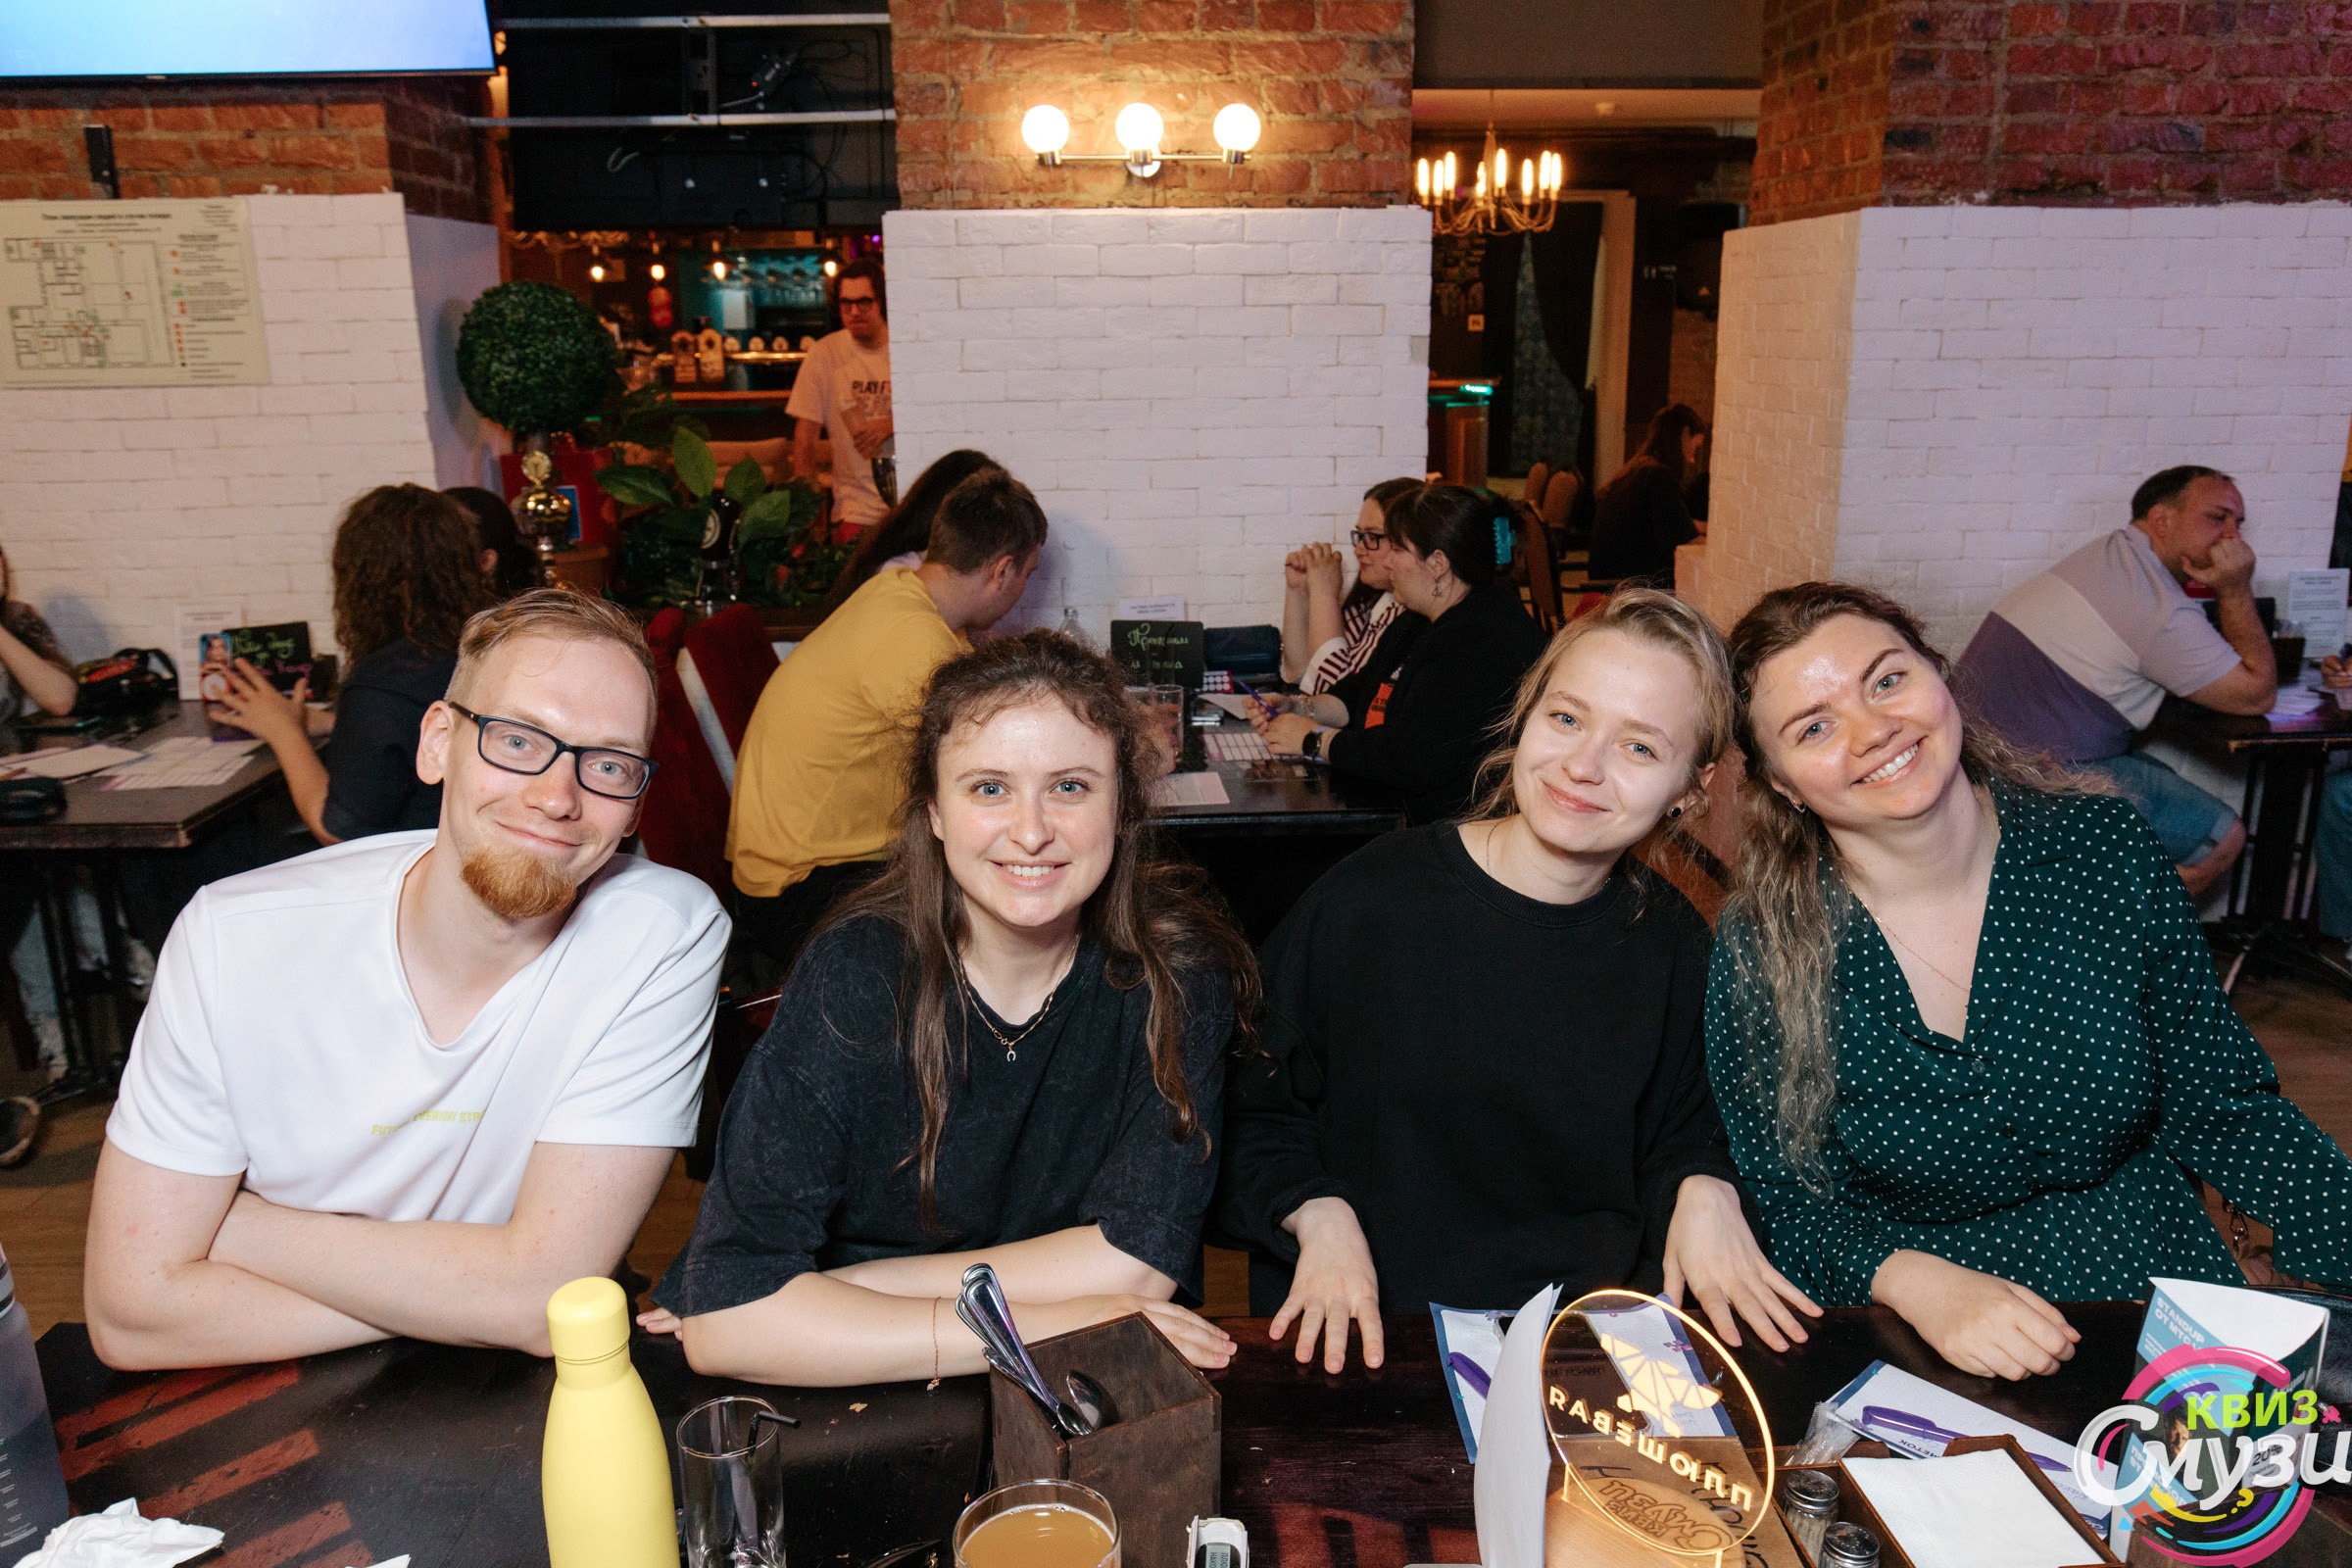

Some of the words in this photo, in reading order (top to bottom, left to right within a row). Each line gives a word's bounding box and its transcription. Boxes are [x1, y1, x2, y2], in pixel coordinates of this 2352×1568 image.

[2155, 1308, 2170, 1325] ОТ
[2156, 1297, 2205, 1344] STANDUP
[1599, 1480, 1734, 1550] Смузи
[1607, 1500, 1668, 1537] КВИЗ
